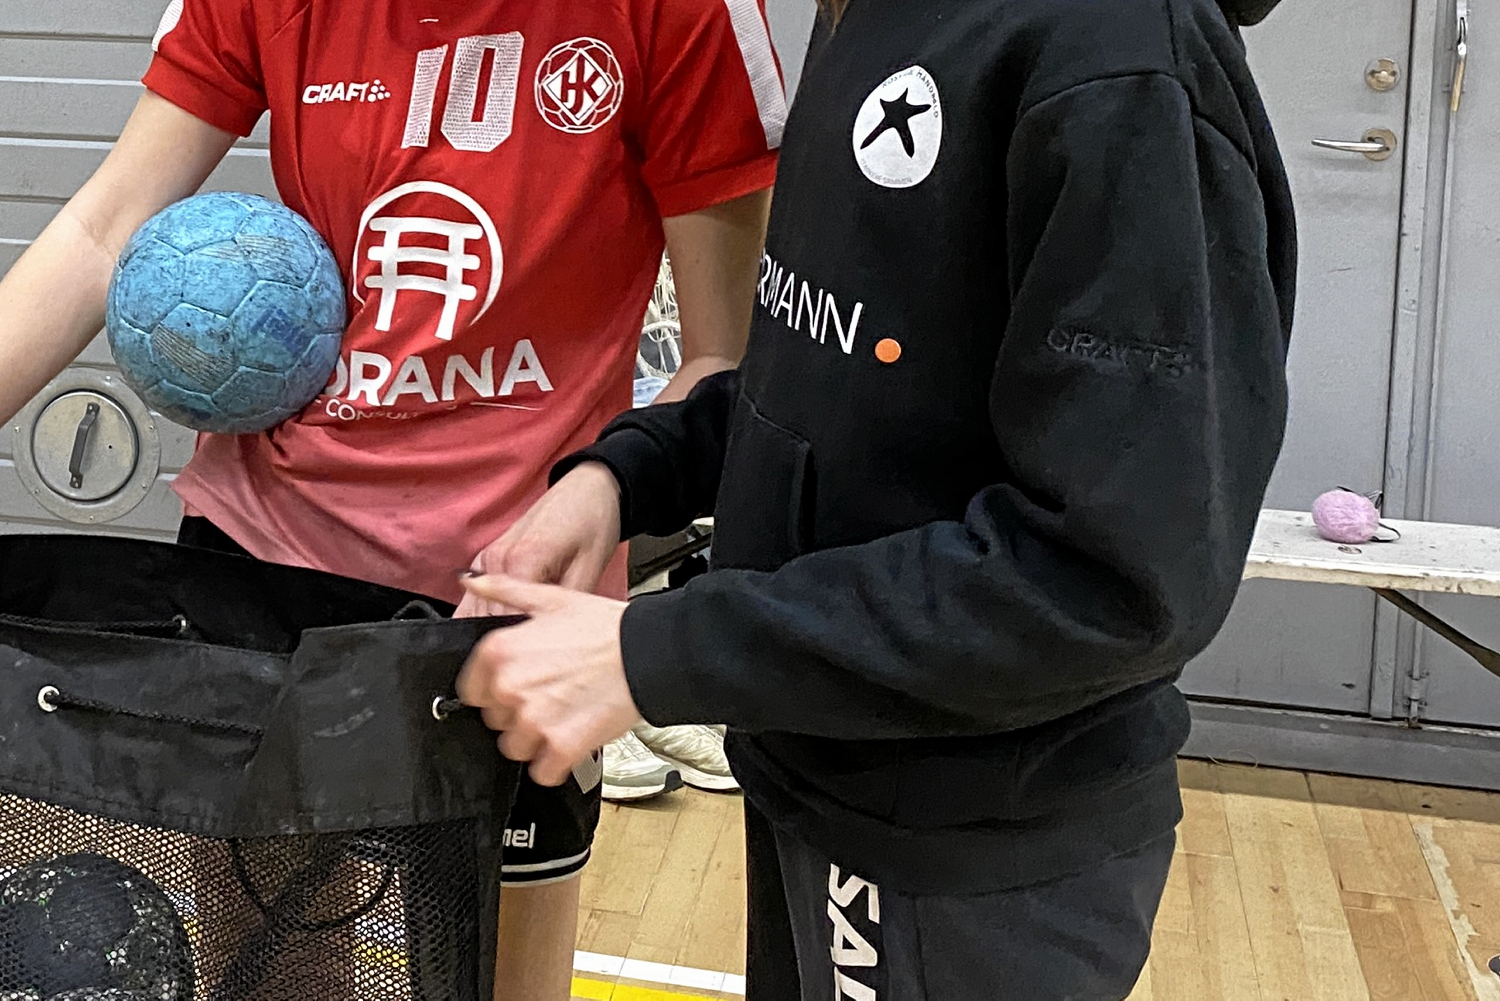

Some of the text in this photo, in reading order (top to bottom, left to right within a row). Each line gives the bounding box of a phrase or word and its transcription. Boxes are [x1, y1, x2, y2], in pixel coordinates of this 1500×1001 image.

[302, 81, 370, 105] CRAFT
[401, 31, 525, 153] 10
[757, 247, 864, 355] RMANN
